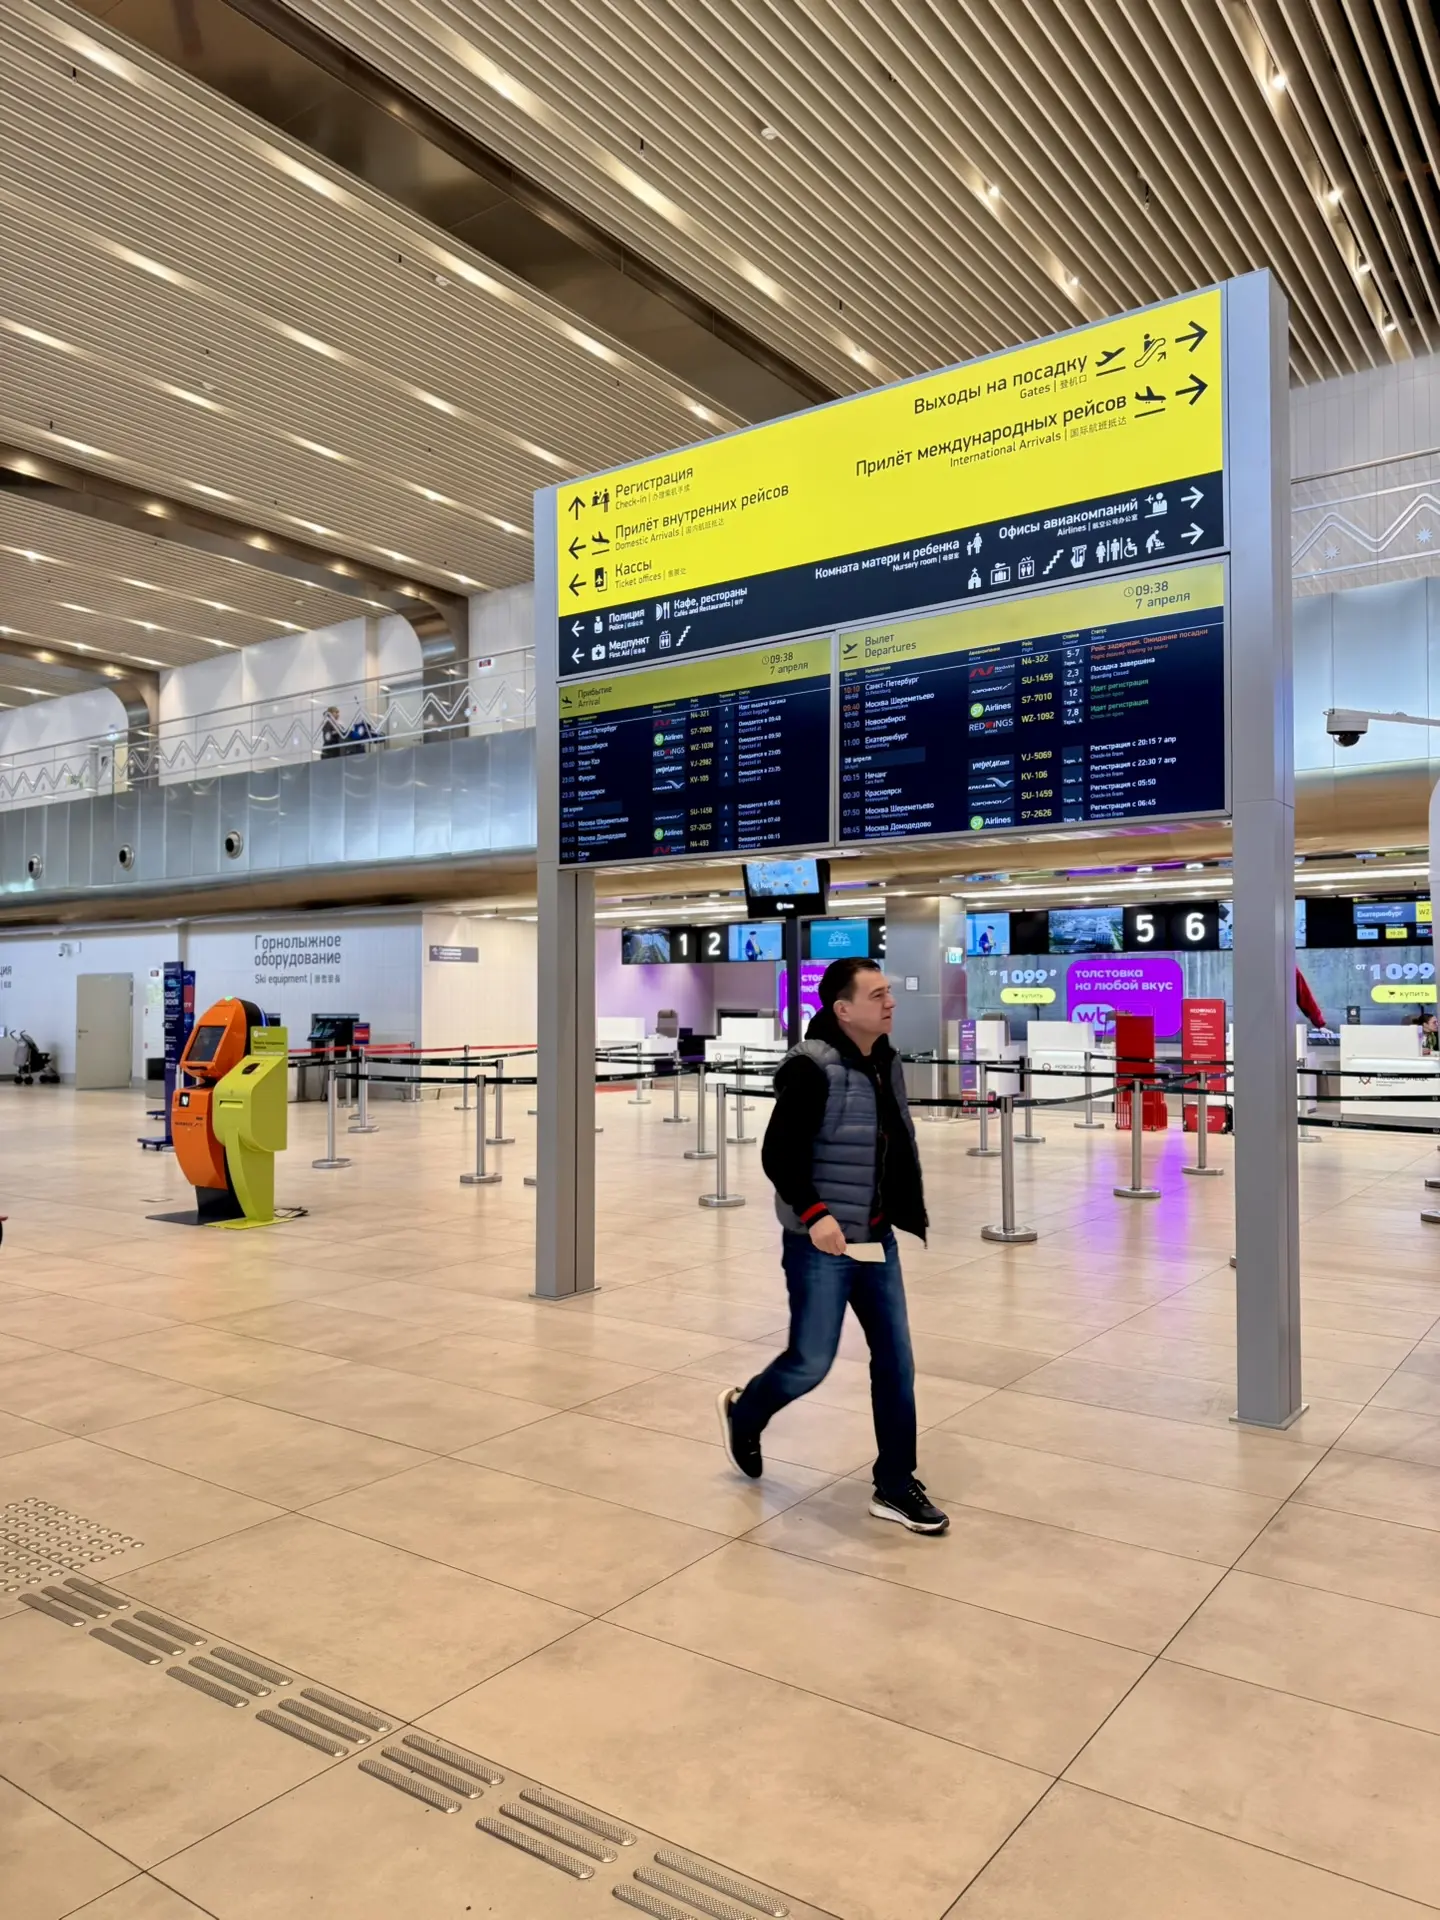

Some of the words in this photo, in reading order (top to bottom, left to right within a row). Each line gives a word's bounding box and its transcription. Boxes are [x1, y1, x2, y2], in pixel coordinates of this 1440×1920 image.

[914, 386, 981, 414] Выходы
[987, 378, 1007, 394] на
[1013, 355, 1088, 387] посадку
[1020, 384, 1051, 399] Gates
[1060, 374, 1088, 391] 登机口
[856, 451, 913, 477] Прилёт
[917, 411, 1057, 460] международных
[1063, 394, 1127, 424] рейсов
[950, 443, 1017, 468] International
[1019, 432, 1062, 452] Arrivals
[615, 467, 694, 498] Регистрация
[615, 494, 647, 510] Check-in
[615, 518, 659, 540] Прилёт
[662, 497, 737, 527] внутренних
[741, 483, 789, 507] рейсов
[998, 523, 1041, 541] Офисы
[1043, 499, 1138, 530] авиакомпаний
[1057, 524, 1087, 537] Airlines
[615, 535, 649, 551] Domestic
[651, 528, 680, 544] Arrivals
[815, 561, 858, 579] Комната
[861, 554, 901, 574] матери
[903, 551, 910, 562] и
[912, 540, 960, 564] ребенка
[892, 560, 918, 572] Nursery
[920, 556, 937, 566] room
[615, 559, 652, 577] Кассы
[615, 576, 637, 589] Ticket
[638, 572, 662, 585] offices
[1135, 581, 1168, 596] 09:38
[674, 597, 699, 609] Кафе,
[701, 587, 748, 605] рестораны
[1136, 598, 1143, 609] 7
[1147, 592, 1191, 608] апреля
[689, 607, 698, 615] and
[700, 601, 730, 612] Restaurants
[609, 609, 645, 623] Полиция
[609, 623, 624, 631] Police
[609, 636, 650, 650] Медпункт
[865, 634, 895, 647] Вылет
[1143, 634, 1178, 644] Ожидание
[1179, 629, 1209, 638] посадки
[865, 642, 917, 658] Departures
[1067, 649, 1080, 658] 5-7
[770, 652, 794, 664] 09:38
[770, 666, 775, 675] 7
[778, 662, 809, 674] апреля
[1090, 664, 1118, 673] Посадка
[1119, 658, 1156, 668] завершена
[1021, 673, 1054, 685] SU-1459
[1067, 669, 1080, 678] 2,3
[865, 677, 920, 691] Санкт-Петербург
[1108, 679, 1149, 690] регистрация
[578, 686, 613, 702] Прибытие
[1021, 692, 1053, 704] S7-7010
[1069, 688, 1078, 697] 12
[578, 697, 601, 708] Arrival
[865, 700, 889, 709] Москва
[890, 693, 935, 705] Шереметьево
[1108, 699, 1149, 711] регистрация
[984, 703, 1012, 713] Airlines
[1067, 708, 1080, 717] 7,8
[865, 715, 907, 726] Новосибирск
[1021, 711, 1055, 723] WZ-1092
[844, 721, 860, 729] 10:30
[664, 733, 684, 741] Airlines
[844, 738, 860, 747] 11:00
[865, 733, 909, 744] Екатеринбург
[1090, 742, 1131, 751] Регистрация
[1137, 737, 1156, 746] 20:15
[1090, 762, 1131, 771] Регистрация
[1137, 758, 1156, 767] 22:30
[843, 773, 860, 782] 00:15
[1090, 782, 1131, 791] Регистрация
[1137, 778, 1156, 787] 05:50
[843, 791, 860, 799] 00:30
[865, 788, 903, 797] Красноярск
[1021, 789, 1053, 800] SU-1459
[865, 807, 889, 815] Москва
[890, 803, 935, 813] Шереметьево
[1090, 802, 1131, 811] Регистрация
[1137, 799, 1156, 807] 06:45
[1021, 809, 1053, 819] S7-2626
[890, 821, 932, 831] Домодедово
[984, 817, 1012, 825] Airlines
[664, 829, 683, 837] Airlines
[1357, 910, 1404, 918] Екатеринбург
[1136, 915, 1155, 942] 5
[1185, 912, 1205, 941] 6
[254, 934, 341, 952] Горнолыжное
[679, 934, 688, 956] 1
[708, 932, 721, 956] 2
[254, 952, 341, 969] оборудование
[1075, 967, 1144, 979] толстовка
[255, 974, 267, 984] Ski
[268, 974, 308, 986] equipment
[1075, 981, 1092, 991] на
[1095, 979, 1138, 991] любой
[1142, 980, 1174, 992] вкус
[1077, 1006, 1107, 1025] wb
